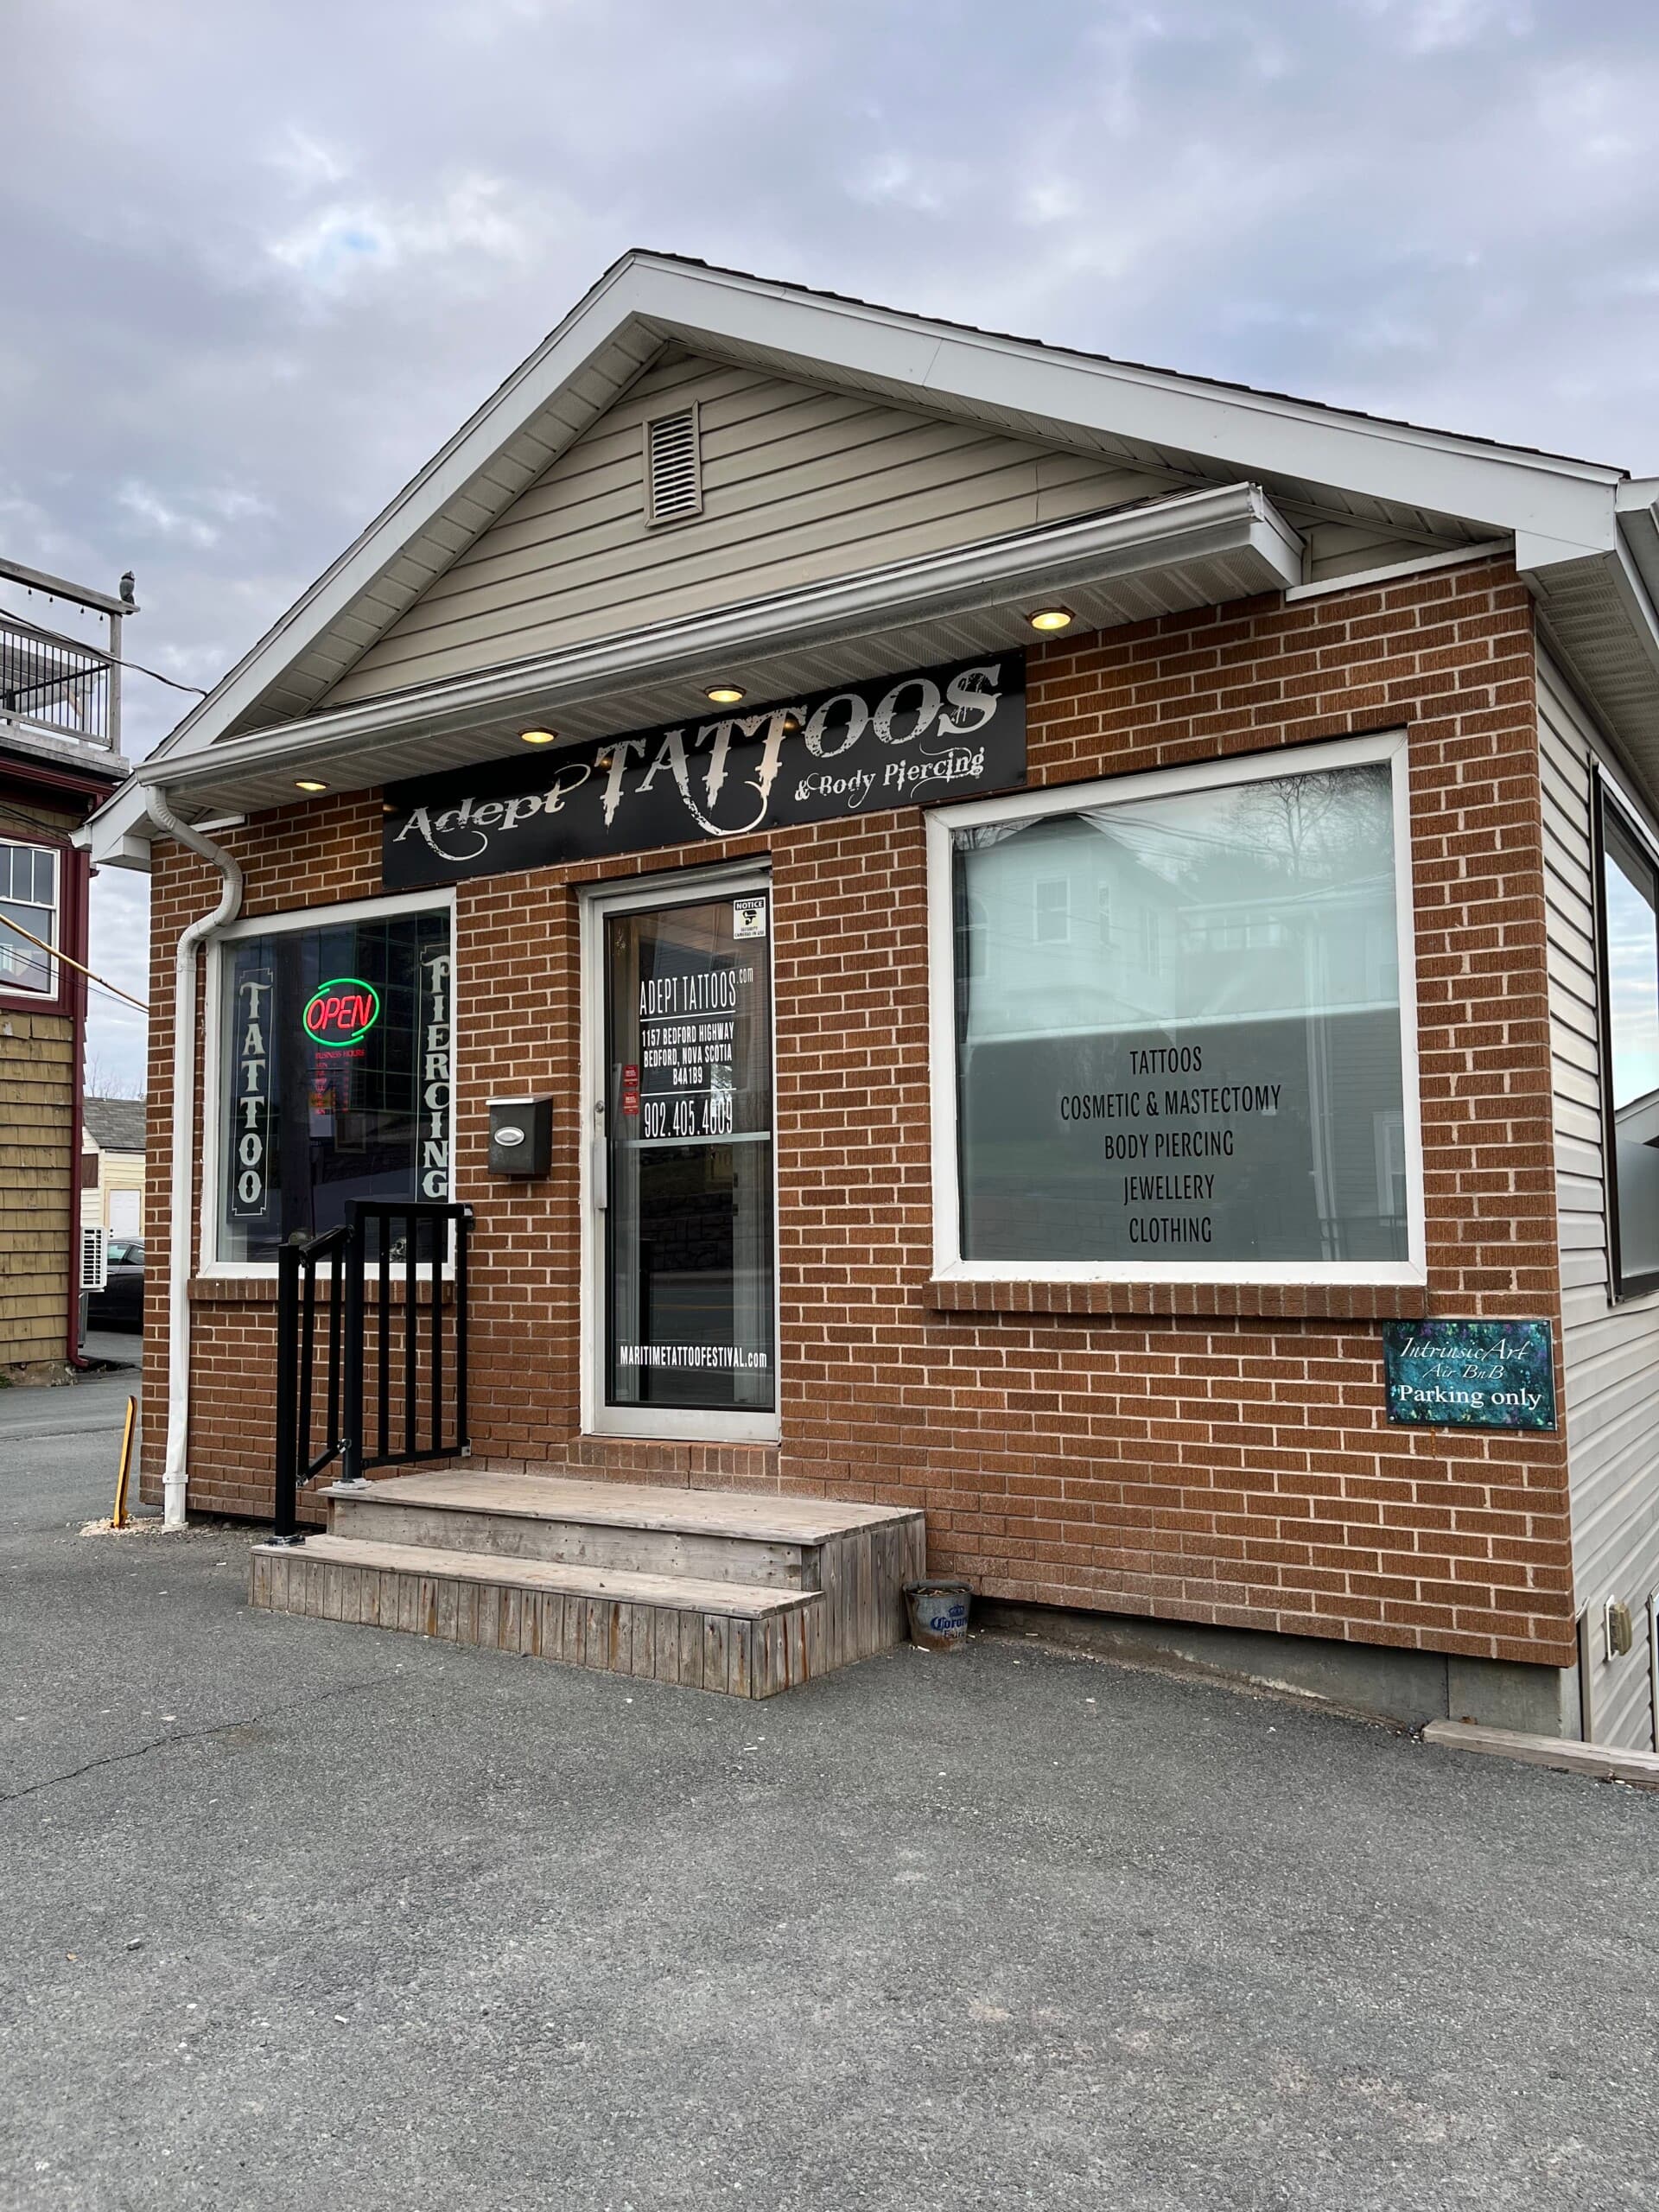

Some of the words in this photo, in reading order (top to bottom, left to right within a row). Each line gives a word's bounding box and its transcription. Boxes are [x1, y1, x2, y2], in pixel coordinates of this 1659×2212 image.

[392, 764, 591, 861] Adept
[593, 664, 1002, 836] TATTOOS
[794, 779, 810, 801] &
[807, 770, 876, 808] Body
[882, 742, 985, 798] Piercing
[639, 977, 677, 1015] ADEPT
[307, 994, 373, 1031] OPEN
[642, 1028, 660, 1047] 1157
[663, 1025, 696, 1046] BEDFORD
[699, 1021, 734, 1042] HIGHWAY
[644, 1048, 680, 1068] BEDFORD,
[682, 1046, 702, 1065] NOVA
[704, 1043, 733, 1063] SCOTIA
[1129, 1046, 1202, 1075] TATTOOS
[421, 955, 450, 1198] PIERCING
[238, 982, 273, 1204] TATTOO
[1060, 1091, 1140, 1121] COSMETIC
[1146, 1091, 1159, 1116] &
[1165, 1084, 1281, 1116] MASTECTOMY
[1104, 1134, 1149, 1160] BODY
[1154, 1129, 1234, 1158] PIERCING
[1123, 1174, 1215, 1206] JEWELLERY
[1128, 1217, 1212, 1243] CLOTHING
[620, 1345, 767, 1368] MARITIMETATTOOFESTIVAL.com
[1399, 1338, 1484, 1361] Intrinsic
[1481, 1338, 1530, 1362] Art
[1422, 1363, 1456, 1378] Air
[1462, 1364, 1505, 1380] BnB
[1399, 1384, 1484, 1408] Parking
[1491, 1388, 1542, 1411] only
